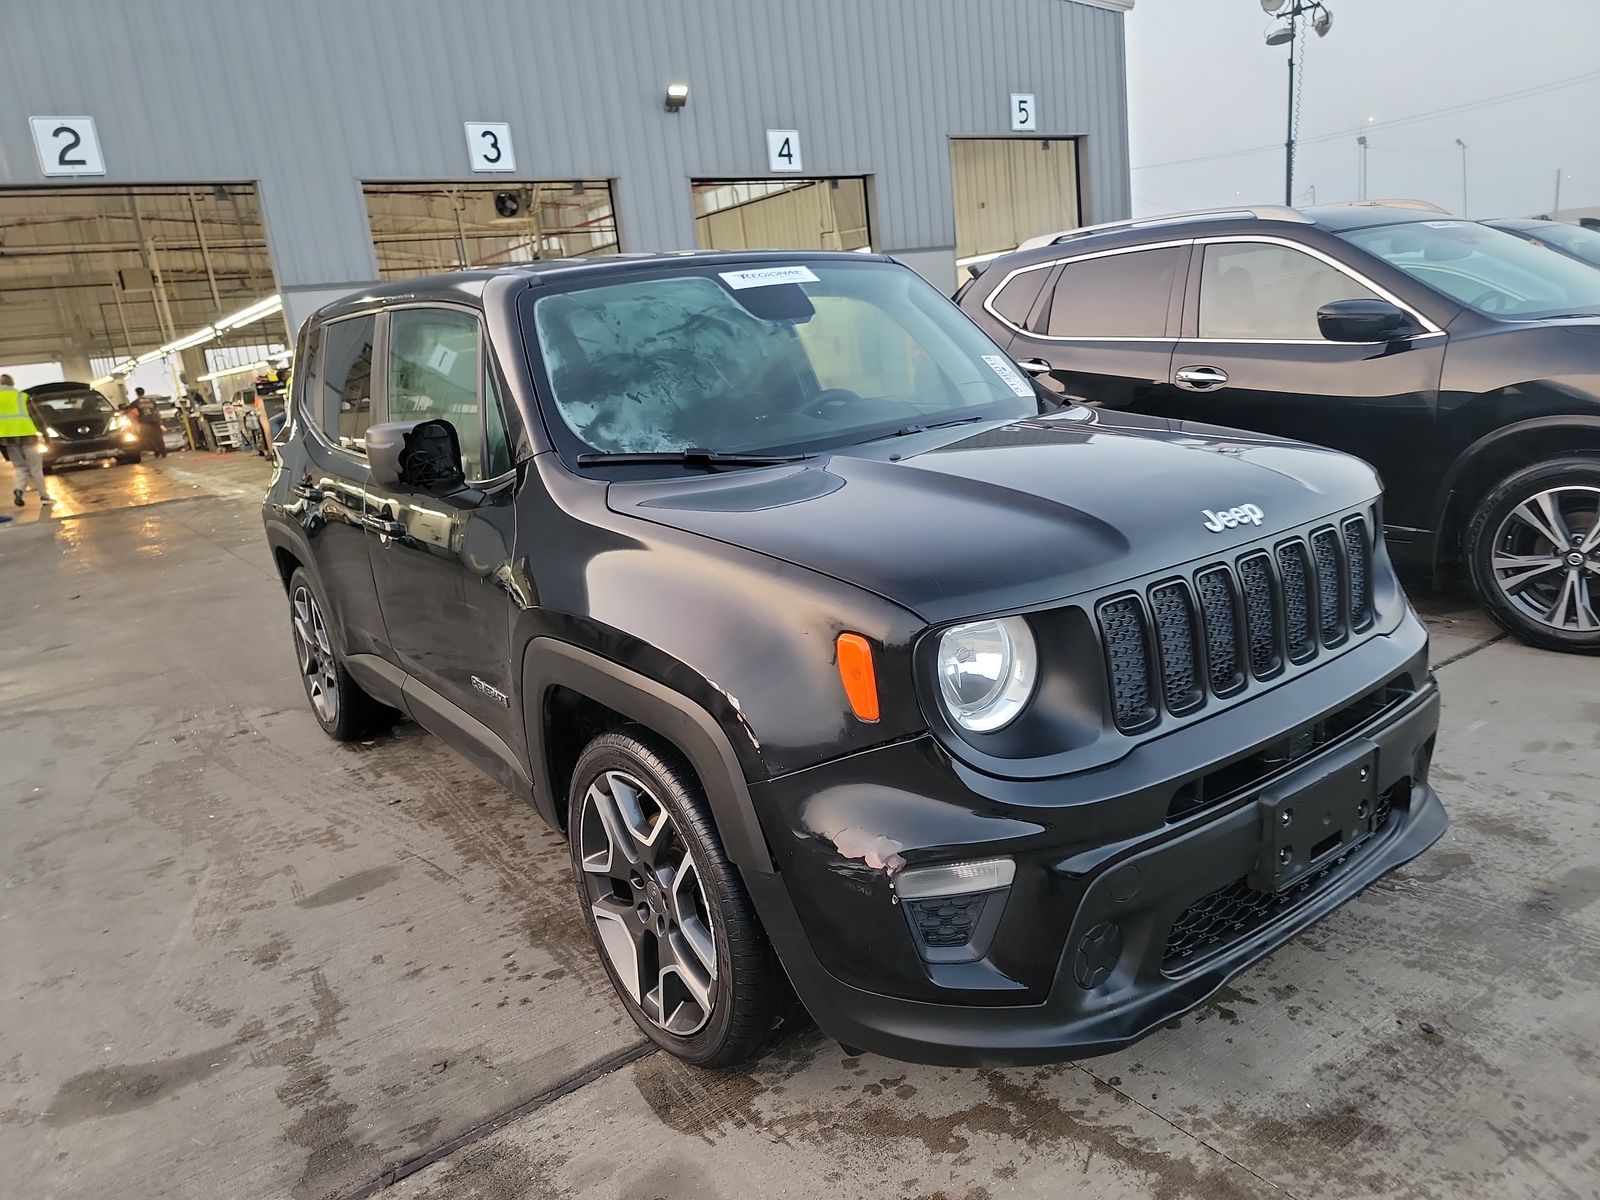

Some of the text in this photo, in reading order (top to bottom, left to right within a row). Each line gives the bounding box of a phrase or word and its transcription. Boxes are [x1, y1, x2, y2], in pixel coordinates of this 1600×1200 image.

[1018, 99, 1029, 125] 5
[52, 126, 88, 166] 2
[481, 130, 502, 164] 3
[777, 137, 793, 165] 4
[1201, 502, 1265, 533] Jeep
